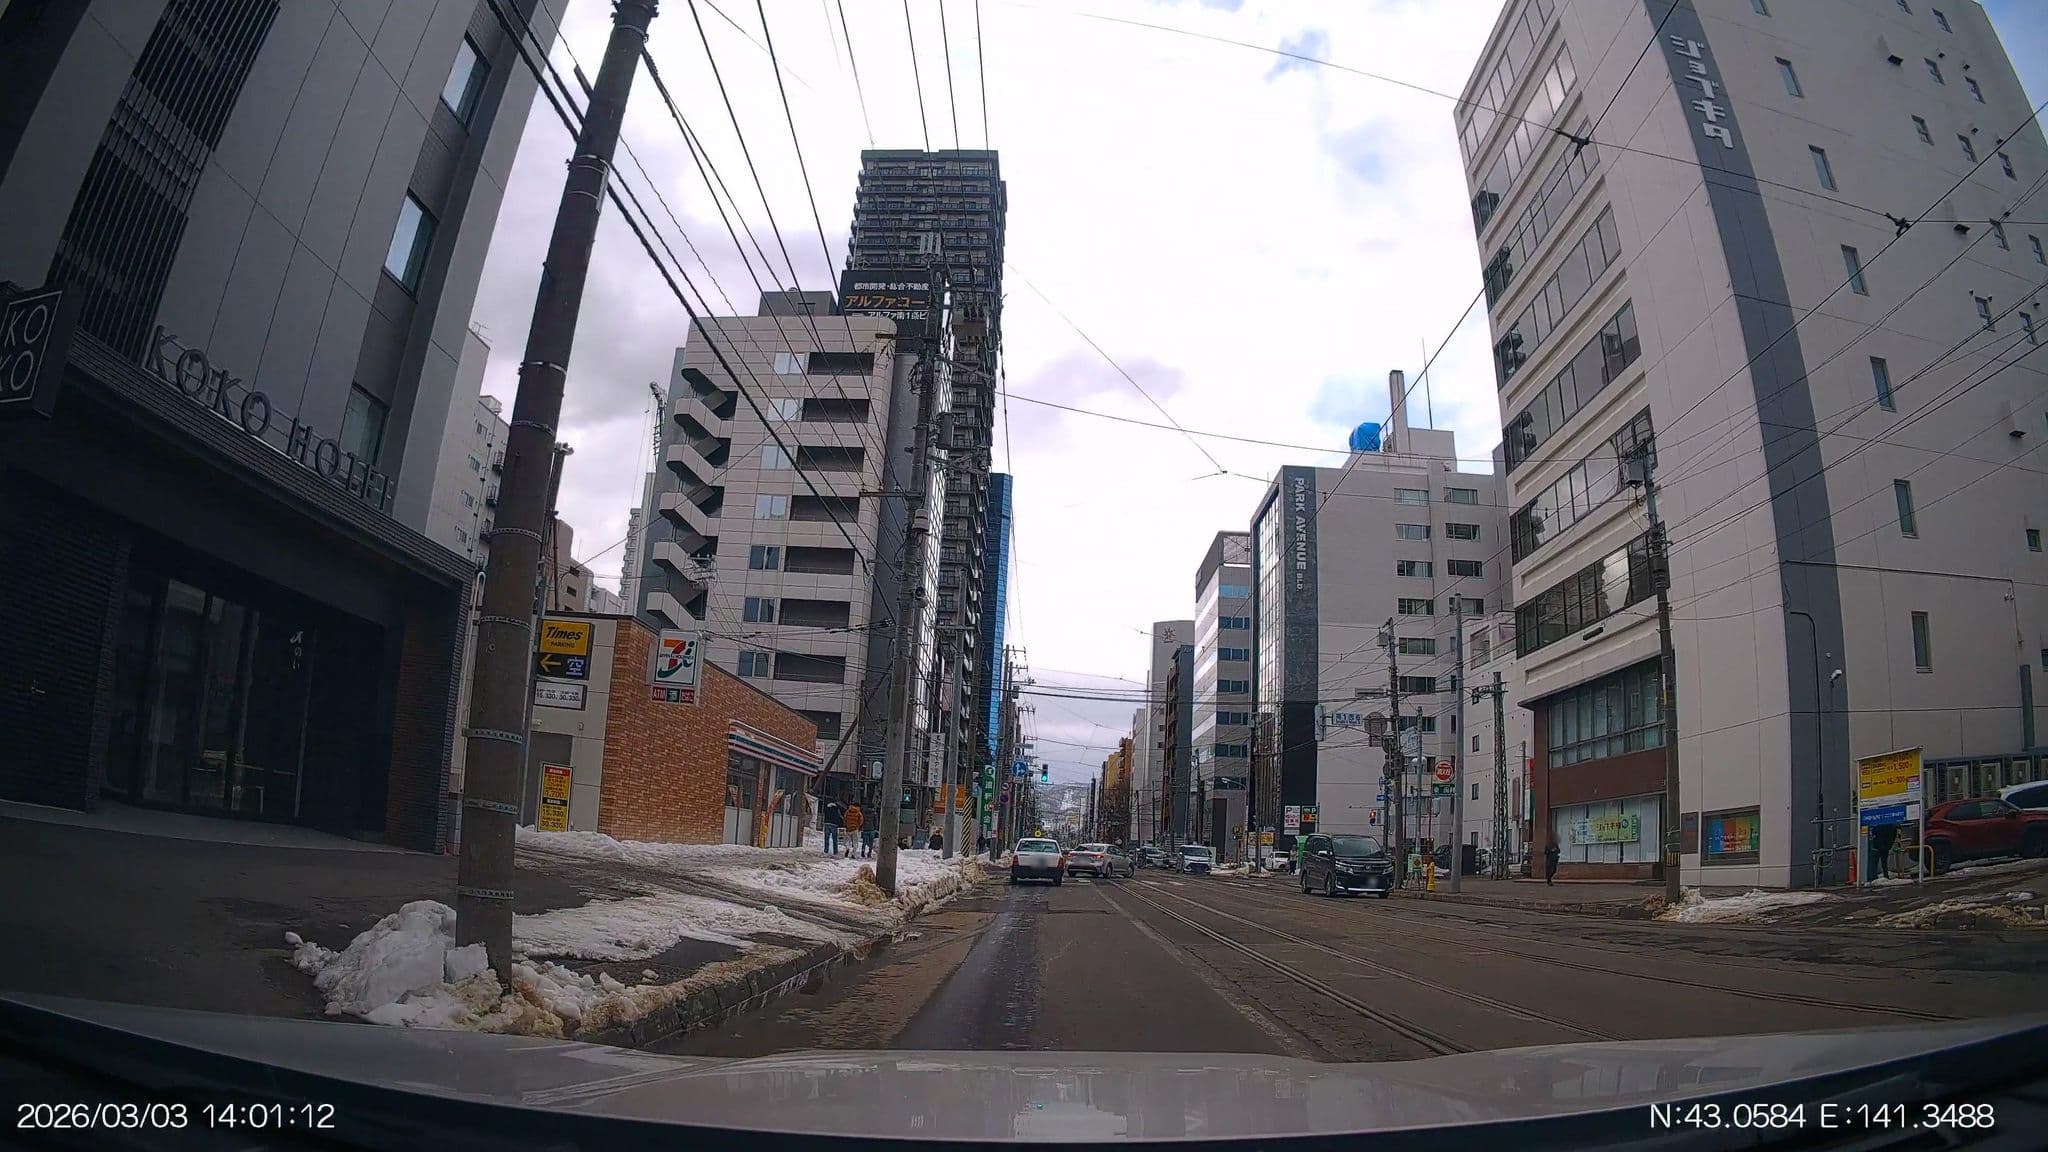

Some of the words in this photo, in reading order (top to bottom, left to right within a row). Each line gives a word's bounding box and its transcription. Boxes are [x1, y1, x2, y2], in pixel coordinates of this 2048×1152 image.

[1670, 35, 1734, 149] ジョブキタ
[845, 294, 930, 309] アルファコー
[4, 304, 48, 347] KO
[145, 325, 272, 437] KOKO
[1294, 477, 1306, 512] PARK
[1295, 515, 1307, 570] AVENUE
[545, 626, 583, 640] Times
[550, 641, 576, 649] PARKING
[652, 687, 666, 699] ATM
